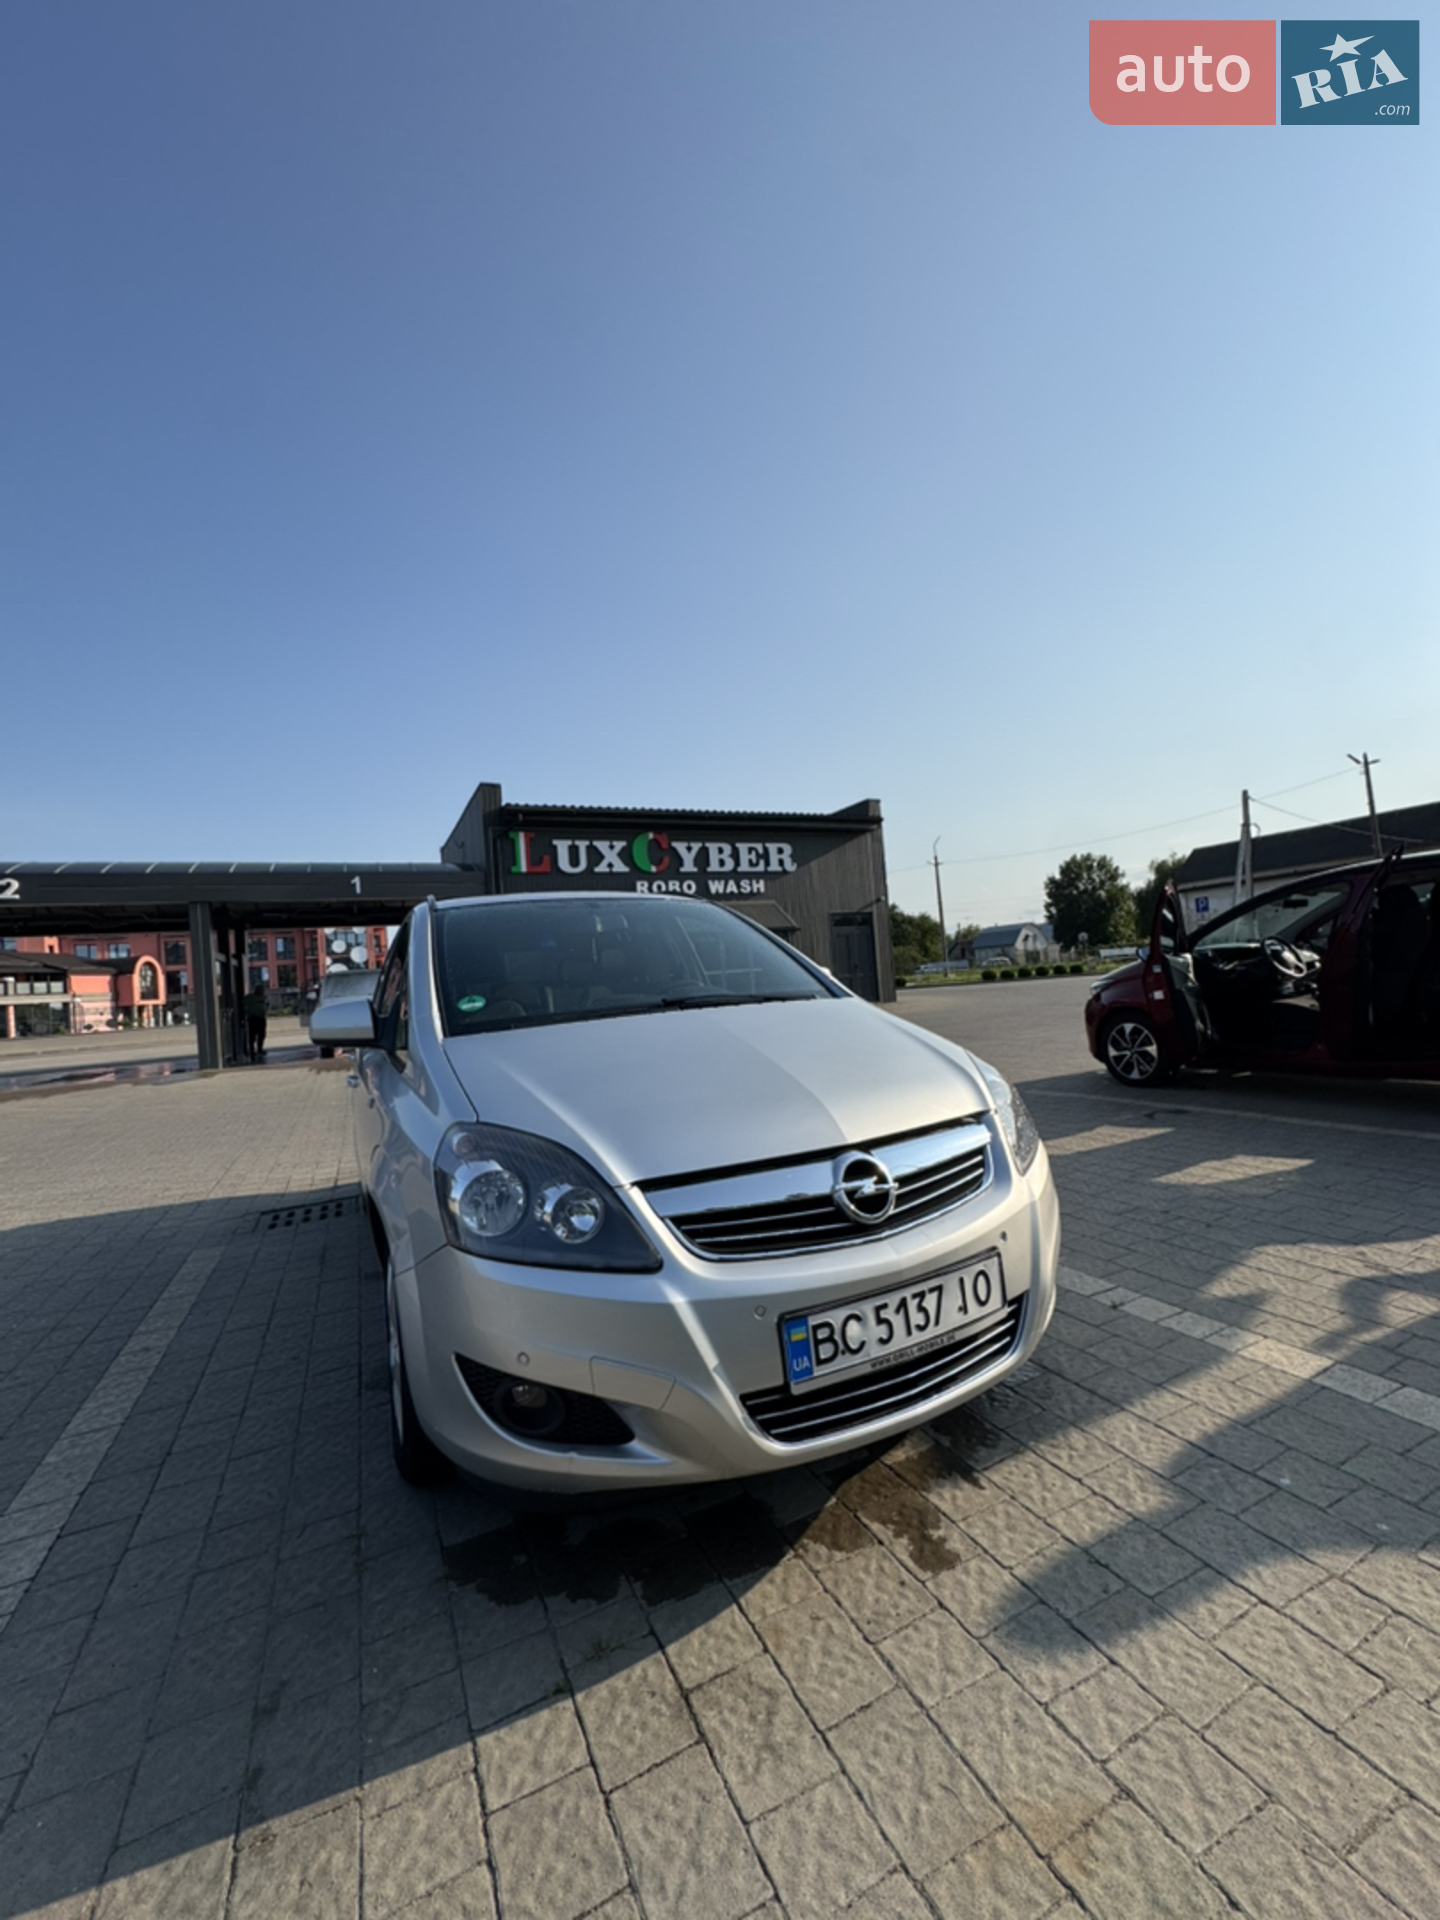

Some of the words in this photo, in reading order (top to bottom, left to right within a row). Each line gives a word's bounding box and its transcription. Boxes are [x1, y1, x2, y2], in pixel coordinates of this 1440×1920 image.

[0, 878, 20, 899] 2
[351, 876, 361, 894] 1
[636, 879, 697, 895] ROBO
[707, 879, 766, 895] WASH
[811, 1313, 867, 1366] BC
[874, 1284, 944, 1345] 5137
[959, 1269, 992, 1316] IO
[793, 1355, 811, 1372] UA
